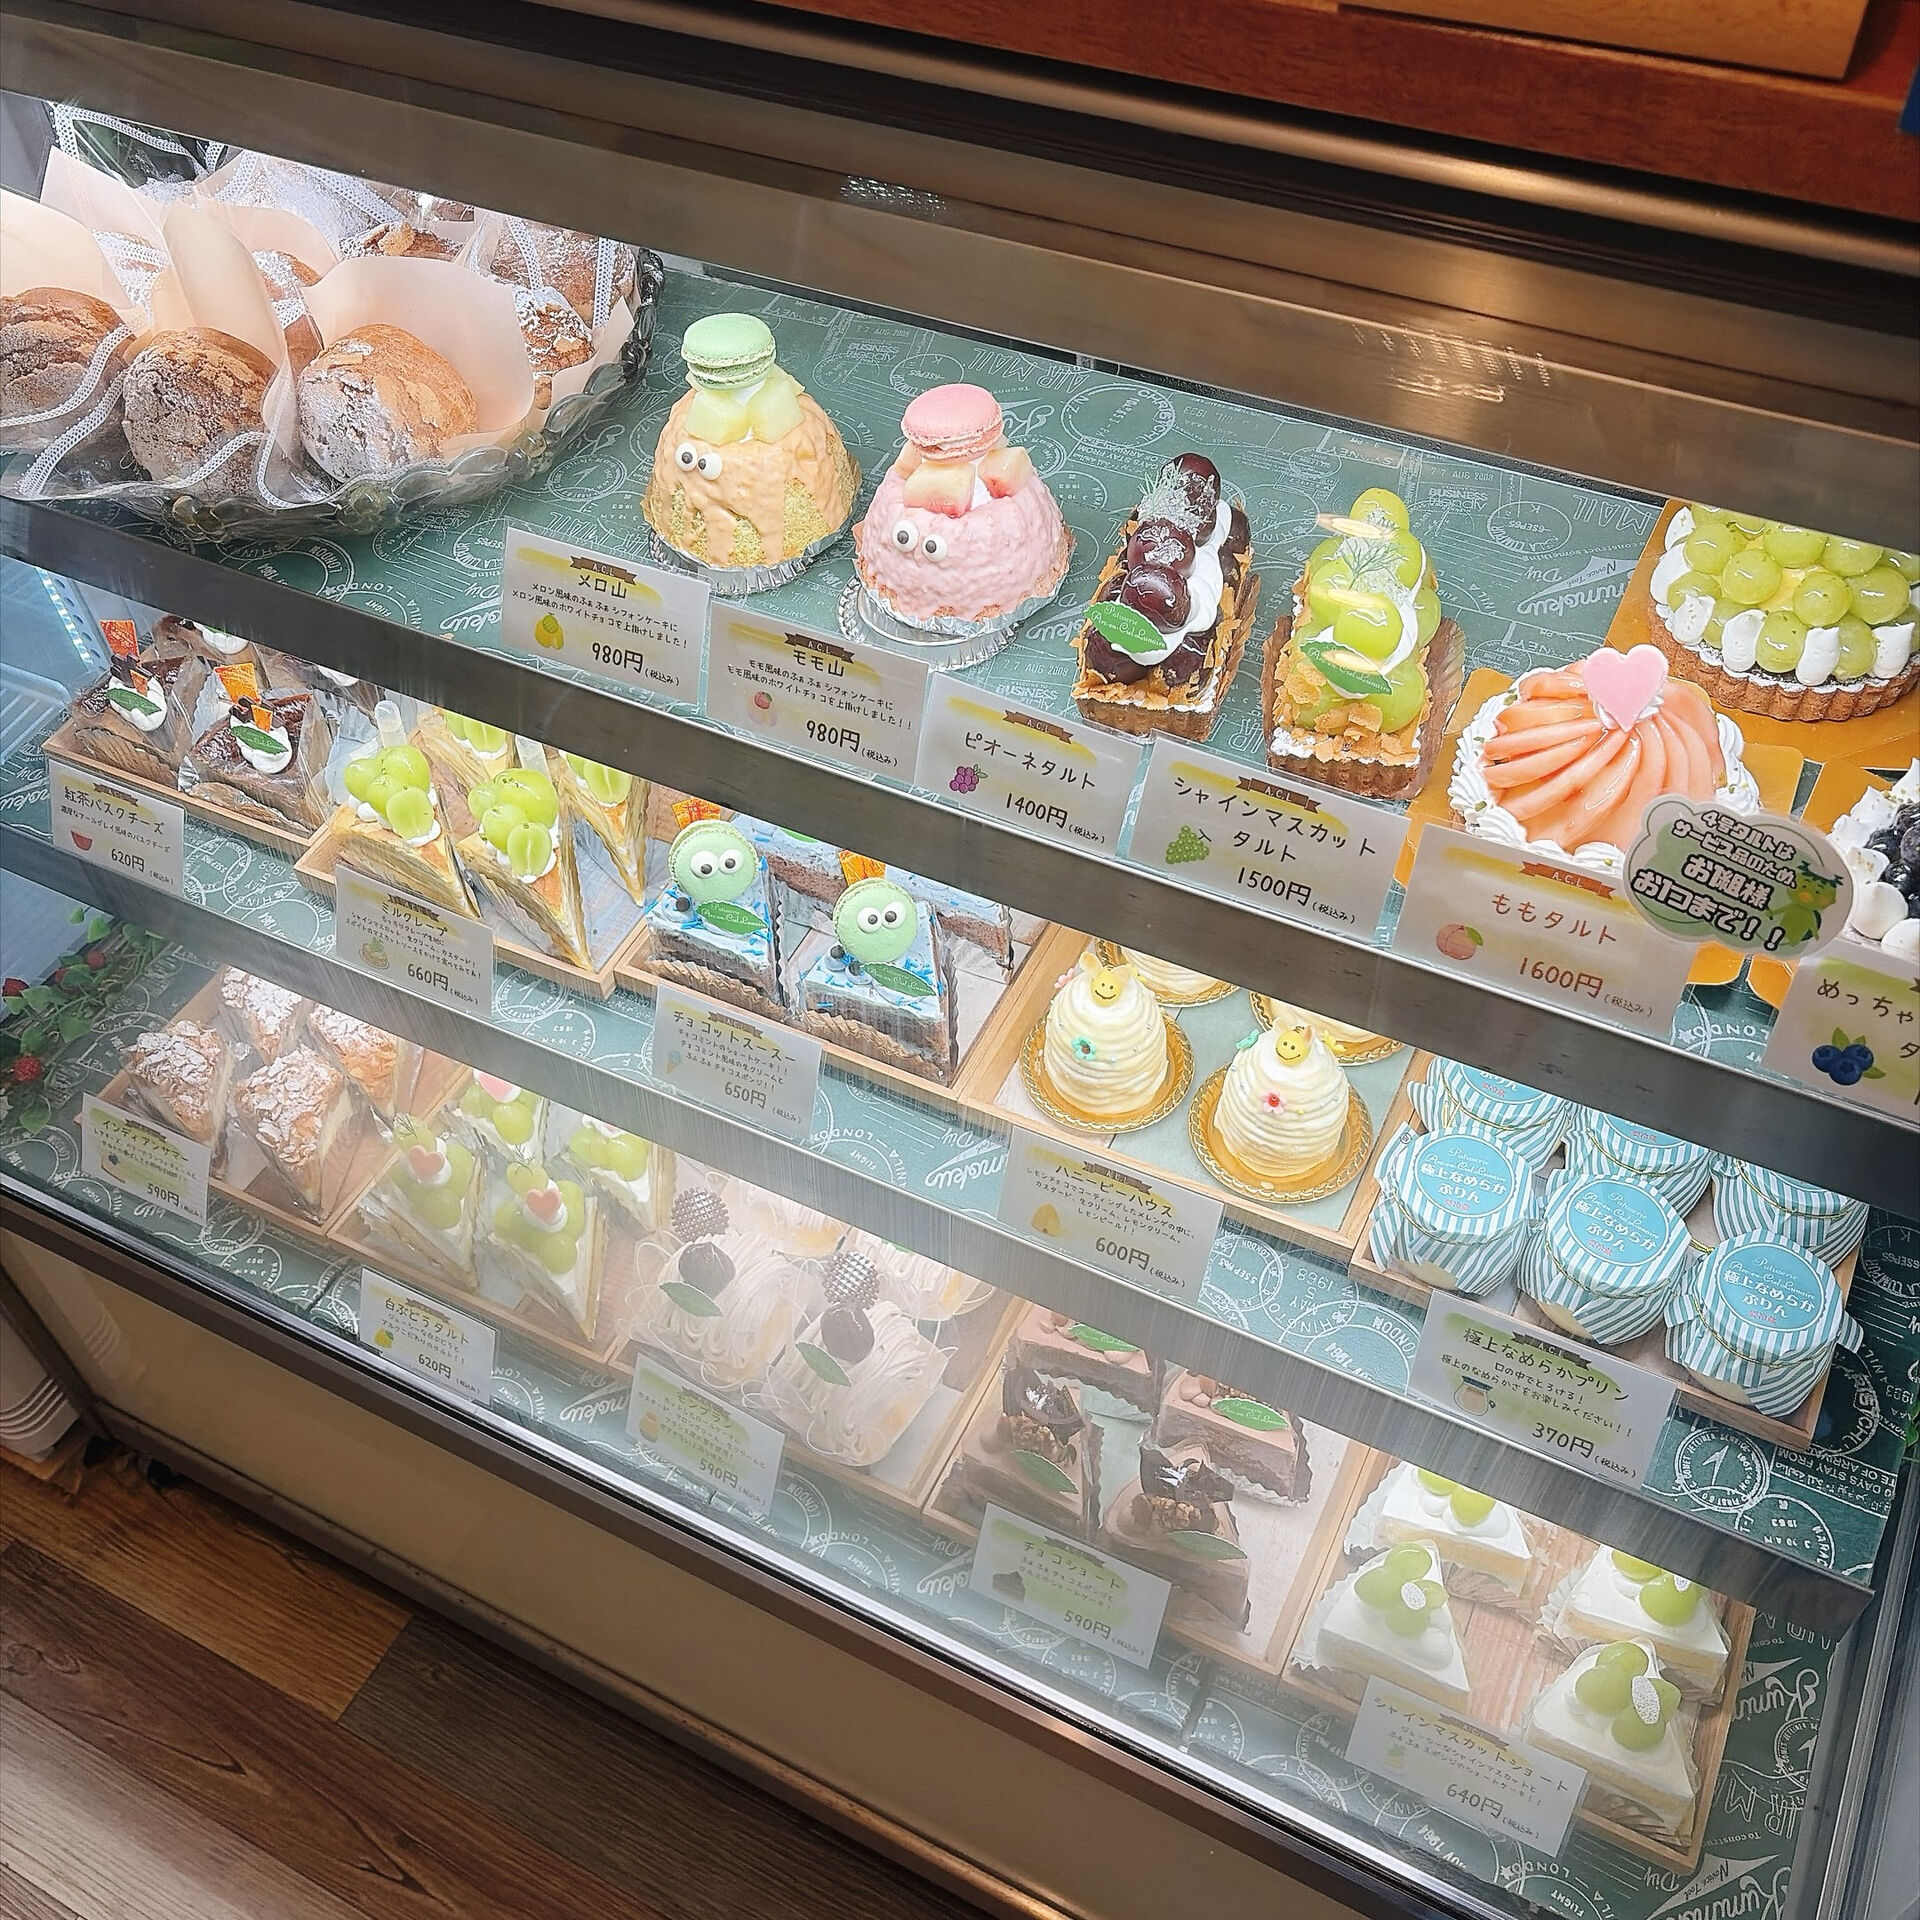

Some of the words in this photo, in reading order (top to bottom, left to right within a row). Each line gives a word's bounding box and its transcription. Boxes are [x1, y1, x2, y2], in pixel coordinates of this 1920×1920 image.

[1573, 493, 1653, 536] MAIL
[578, 574, 628, 599] メロ山
[591, 641, 644, 675] 980円
[792, 649, 845, 678] モモ山
[805, 719, 861, 753] 980円
[965, 731, 1096, 791] ピオーネタルト
[63, 785, 166, 835] 紅茶バスクチーズ
[1005, 792, 1069, 829] 1400円
[1173, 777, 1377, 857] シャインマスカット
[1232, 829, 1297, 863] タルト
[1671, 818, 1799, 891] サービス品のため、
[1701, 809, 1797, 862] 4号タルトは
[111, 847, 145, 873] 620円
[1237, 866, 1313, 907] 1500円
[381, 902, 449, 938] ミルクレープ
[1491, 893, 1617, 946] ももタルト
[407, 962, 449, 993] 660円
[1519, 956, 1604, 999] 1600円
[673, 1009, 797, 1063] チョコットスースー
[724, 1081, 767, 1110] 650円
[147, 1183, 181, 1207] 590円
[1055, 1165, 1173, 1219] ハニービーハウス
[1419, 1162, 1508, 1196] 極上なめらか
[1573, 1199, 1657, 1253] 極上なめらか
[1095, 1237, 1151, 1271] 600円
[1722, 1269, 1817, 1314] 極上なめらか
[385, 1297, 471, 1345] 白ぶどうタルト
[417, 1353, 453, 1380] 620円
[1463, 1327, 1629, 1402] 極上なめらかプリン
[1531, 1422, 1595, 1460] 370円
[699, 1457, 739, 1489] 590円
[1023, 1541, 1121, 1591] チョコショート
[1063, 1609, 1112, 1641] 590円
[1373, 1696, 1569, 1793] シャインマスカットショート
[1446, 1783, 1504, 1820] 640円
